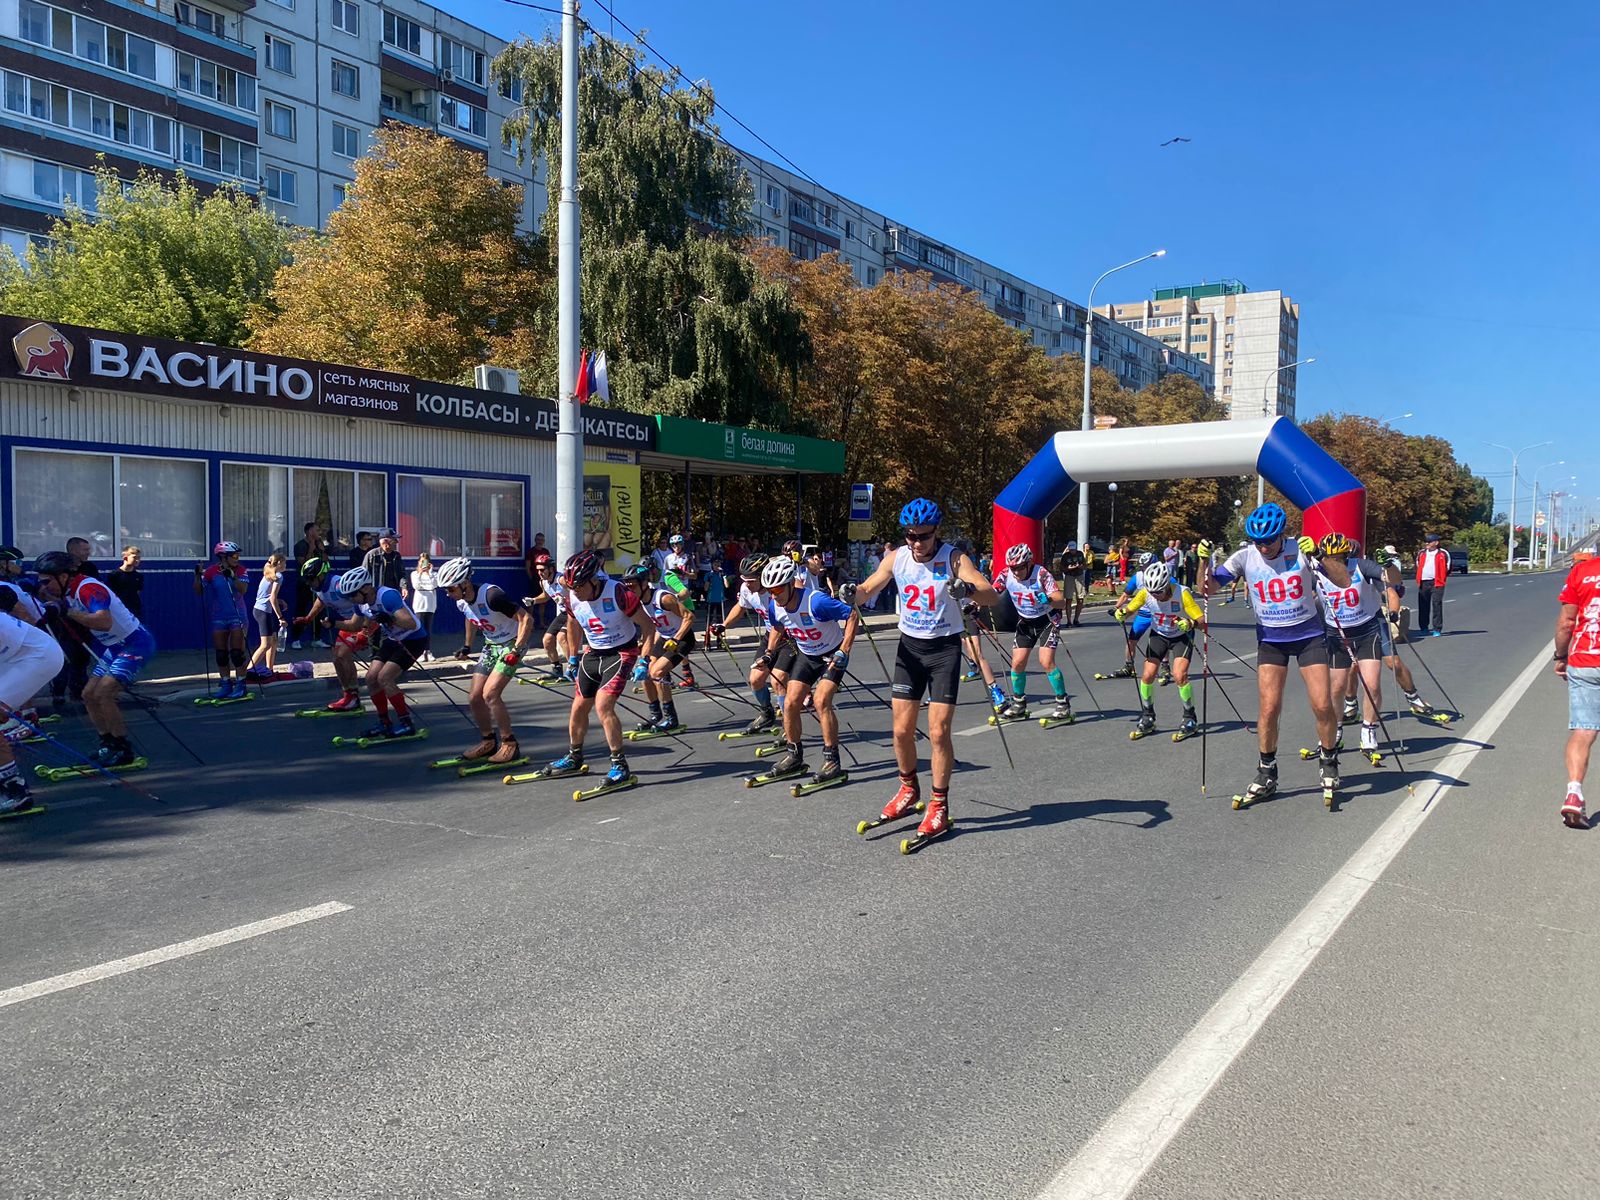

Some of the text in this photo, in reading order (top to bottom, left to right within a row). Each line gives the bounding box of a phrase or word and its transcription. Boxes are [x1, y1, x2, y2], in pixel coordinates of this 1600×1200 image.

[90, 338, 314, 400] ВАСИНО
[323, 372, 410, 394] сеть мясных
[325, 392, 399, 411] магазинов
[416, 393, 649, 442] КОЛБАСЫ ДЕКАТЕСЫ
[741, 432, 795, 455] белая долина
[904, 584, 936, 611] 21
[1253, 575, 1304, 603] 103
[1327, 588, 1360, 610] 70
[588, 617, 605, 634] 5
